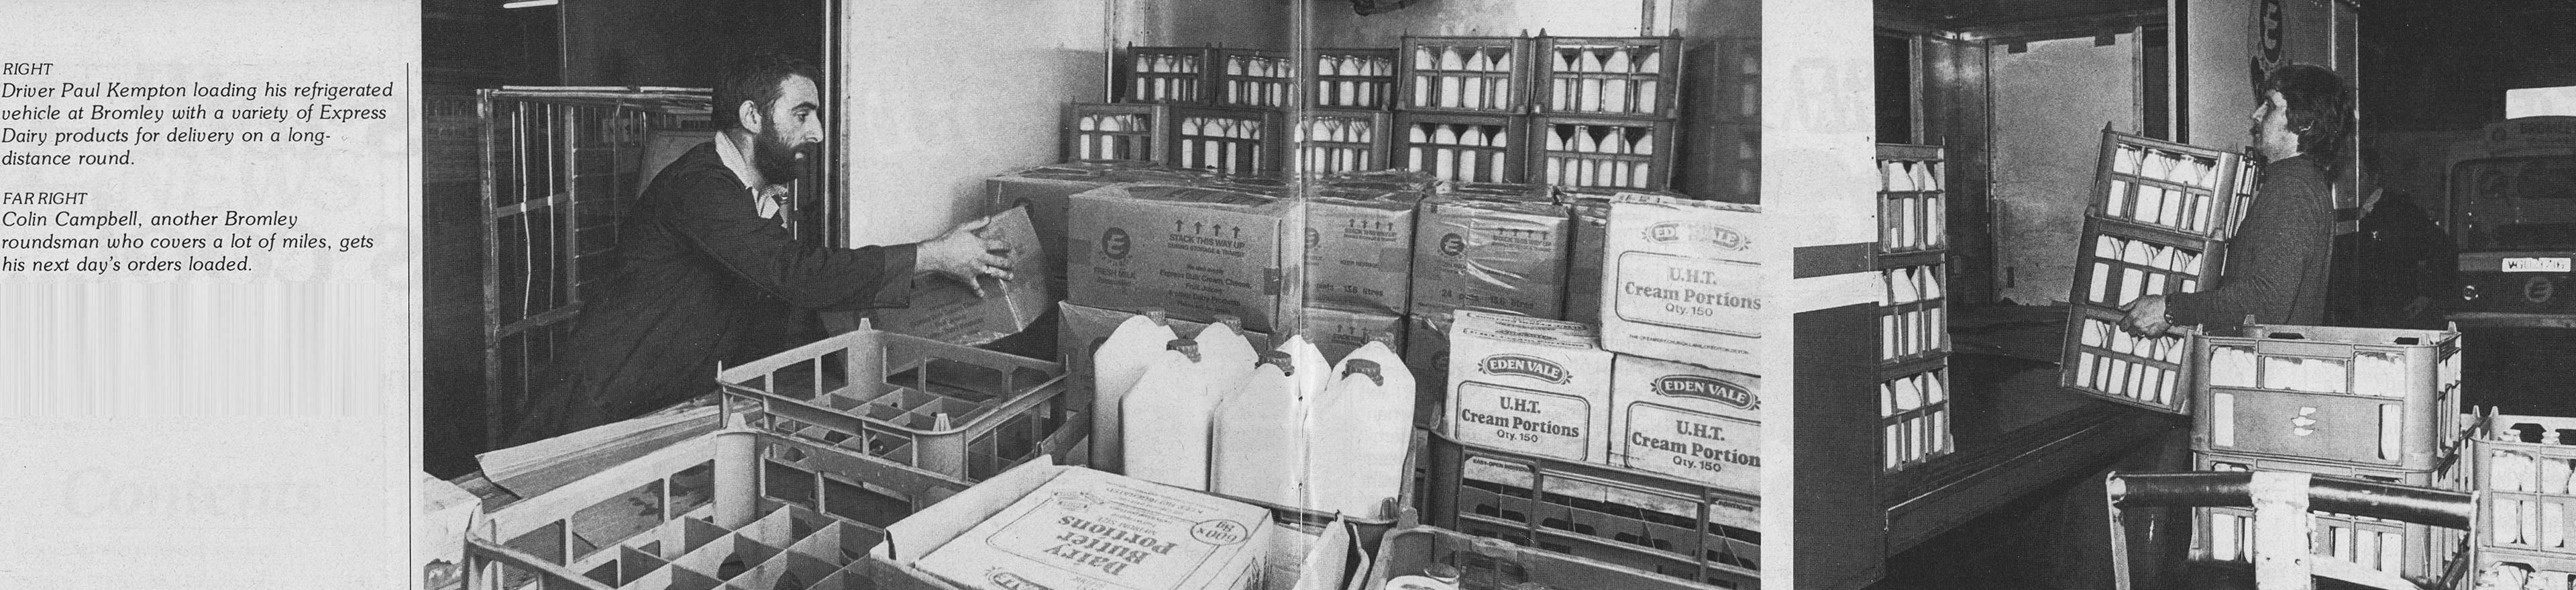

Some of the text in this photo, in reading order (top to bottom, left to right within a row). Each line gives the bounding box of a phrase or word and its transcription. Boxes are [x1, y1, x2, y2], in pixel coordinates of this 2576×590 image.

[3, 63, 53, 75] RIGHT
[2, 81, 392, 100] Driver Paul Kempton loading his refrigerated
[3, 104, 386, 123] vehicle at Bromley with a variety of Express
[2, 127, 330, 146] Dairy products for delivery on a long-
[2, 150, 133, 165] distance round.
[3, 193, 87, 204] FAR RIGHT
[3, 211, 297, 229] Colin Campbell, another Bromley
[3, 233, 373, 252] roundsman who covers a lot of miles, gets
[1169, 234, 1245, 250] STACK THIS WAY UP
[3, 256, 25, 271] his
[34, 258, 69, 271] next
[128, 256, 181, 271] orders
[189, 256, 251, 271] loaded.
[1670, 266, 1717, 285] U.H.T.
[1625, 281, 1761, 310] Cream Portions
[1665, 303, 1713, 317] Qty. 150
[1489, 359, 1560, 379] EDEN VALE
[1664, 380, 1747, 404] EDEN VALE
[1500, 395, 1541, 414] U.H.T.
[1461, 408, 1579, 438] Cream Portions
[1676, 420, 1725, 441] U.H.T.
[1497, 429, 1538, 443] Qty. 150
[1631, 431, 1761, 468] Cream Portion
[1672, 455, 1721, 473] Qty. 150
[1057, 515, 1178, 556] Portions
[1056, 531, 1151, 564] Butter
[1043, 543, 1128, 576] Dairy
